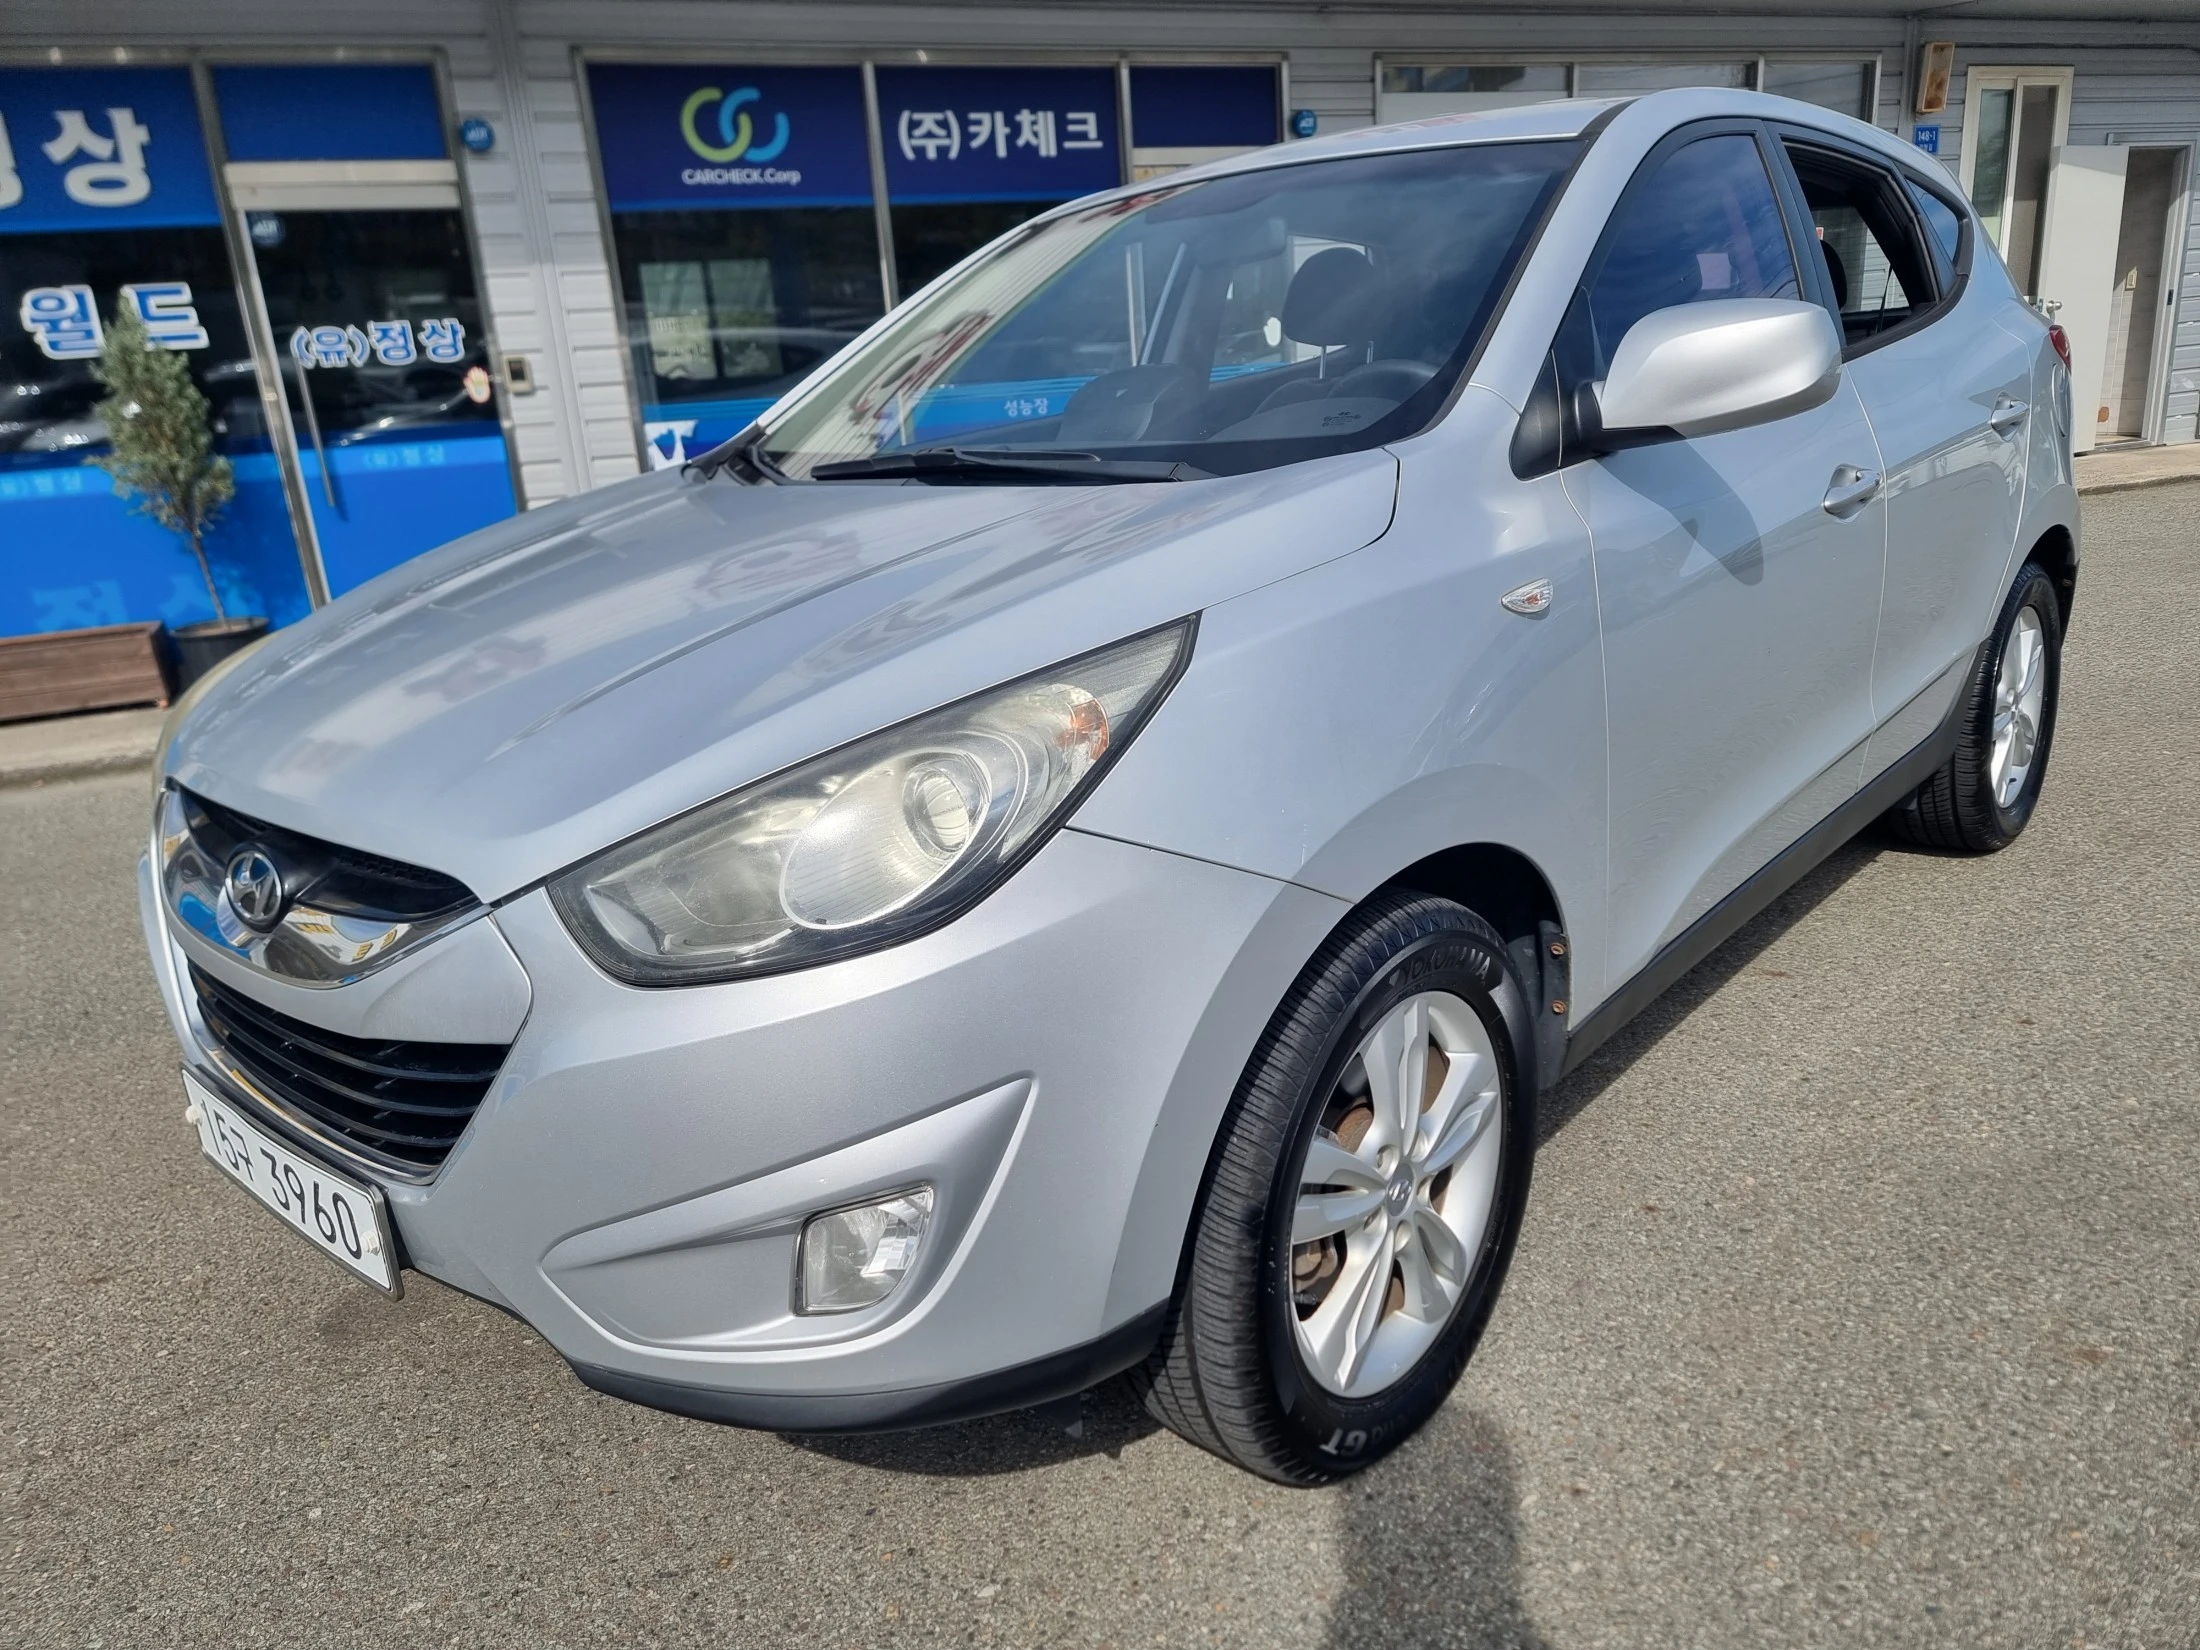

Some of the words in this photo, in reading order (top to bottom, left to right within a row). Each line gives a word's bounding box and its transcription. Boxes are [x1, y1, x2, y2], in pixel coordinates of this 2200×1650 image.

[898, 109, 1104, 161] (주)카체크
[20, 281, 210, 361] 월드
[289, 317, 466, 370] (유)정상
[259, 1146, 362, 1260] 3960
